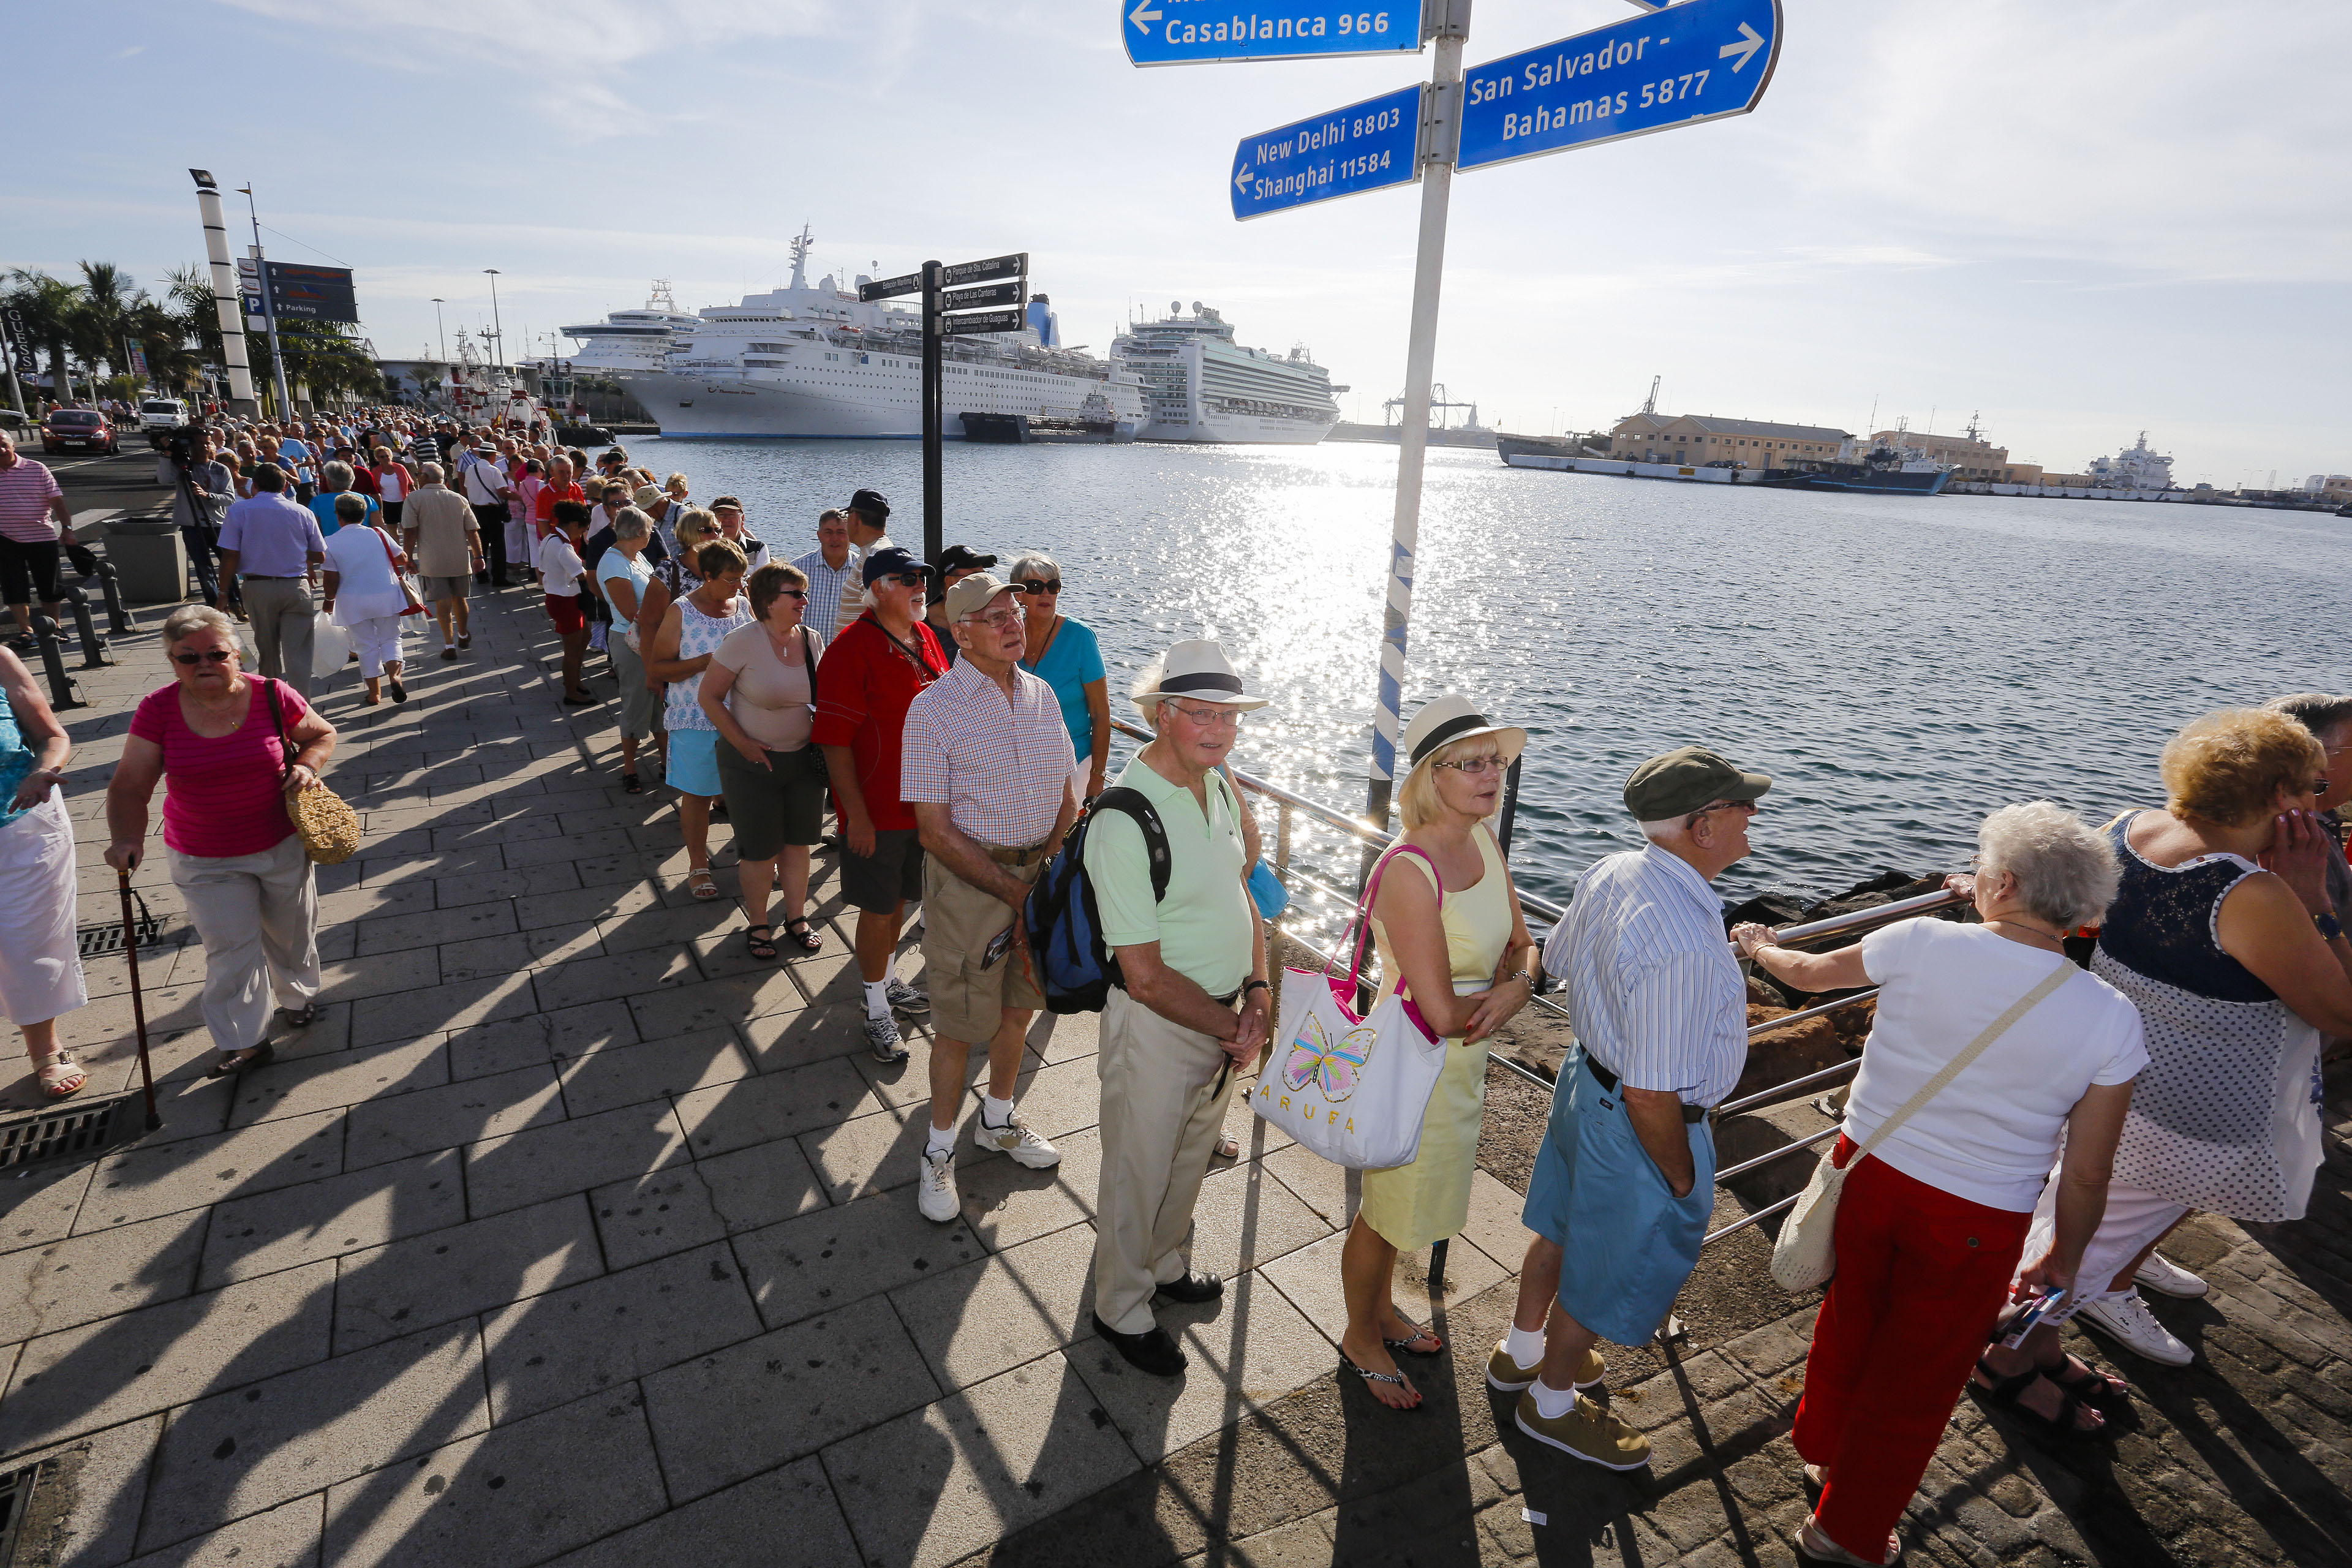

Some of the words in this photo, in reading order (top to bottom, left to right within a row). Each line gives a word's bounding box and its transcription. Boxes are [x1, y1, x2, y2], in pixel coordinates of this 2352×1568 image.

[1165, 13, 1327, 44] Casablanca
[1338, 12, 1389, 36] 966
[1469, 75, 1513, 105] San
[1522, 36, 1651, 91] Salvador
[1502, 91, 1629, 141] Bahamas
[1639, 69, 1711, 109] 5877
[1256, 140, 1293, 165] New
[1298, 118, 1346, 154] Delhi
[1352, 107, 1400, 138] 8803
[1254, 159, 1335, 200] Shanghai
[1340, 149, 1391, 180] 11584
[952, 267, 967, 277] Parque
[982, 261, 1000, 271] Catalina
[249, 298, 260, 312] P
[286, 304, 316, 314] Parking
[837, 292, 858, 301] Thomson
[952, 292, 963, 302] Playa
[963, 291, 969, 300] de
[978, 289, 997, 298] Canteras
[952, 315, 982, 325] Intercambiador
[982, 315, 989, 323] de
[989, 314, 1008, 324] Guaguas
[7, 309, 32, 368] GUESS
[1260, 1084, 1355, 1135] ARUBA
